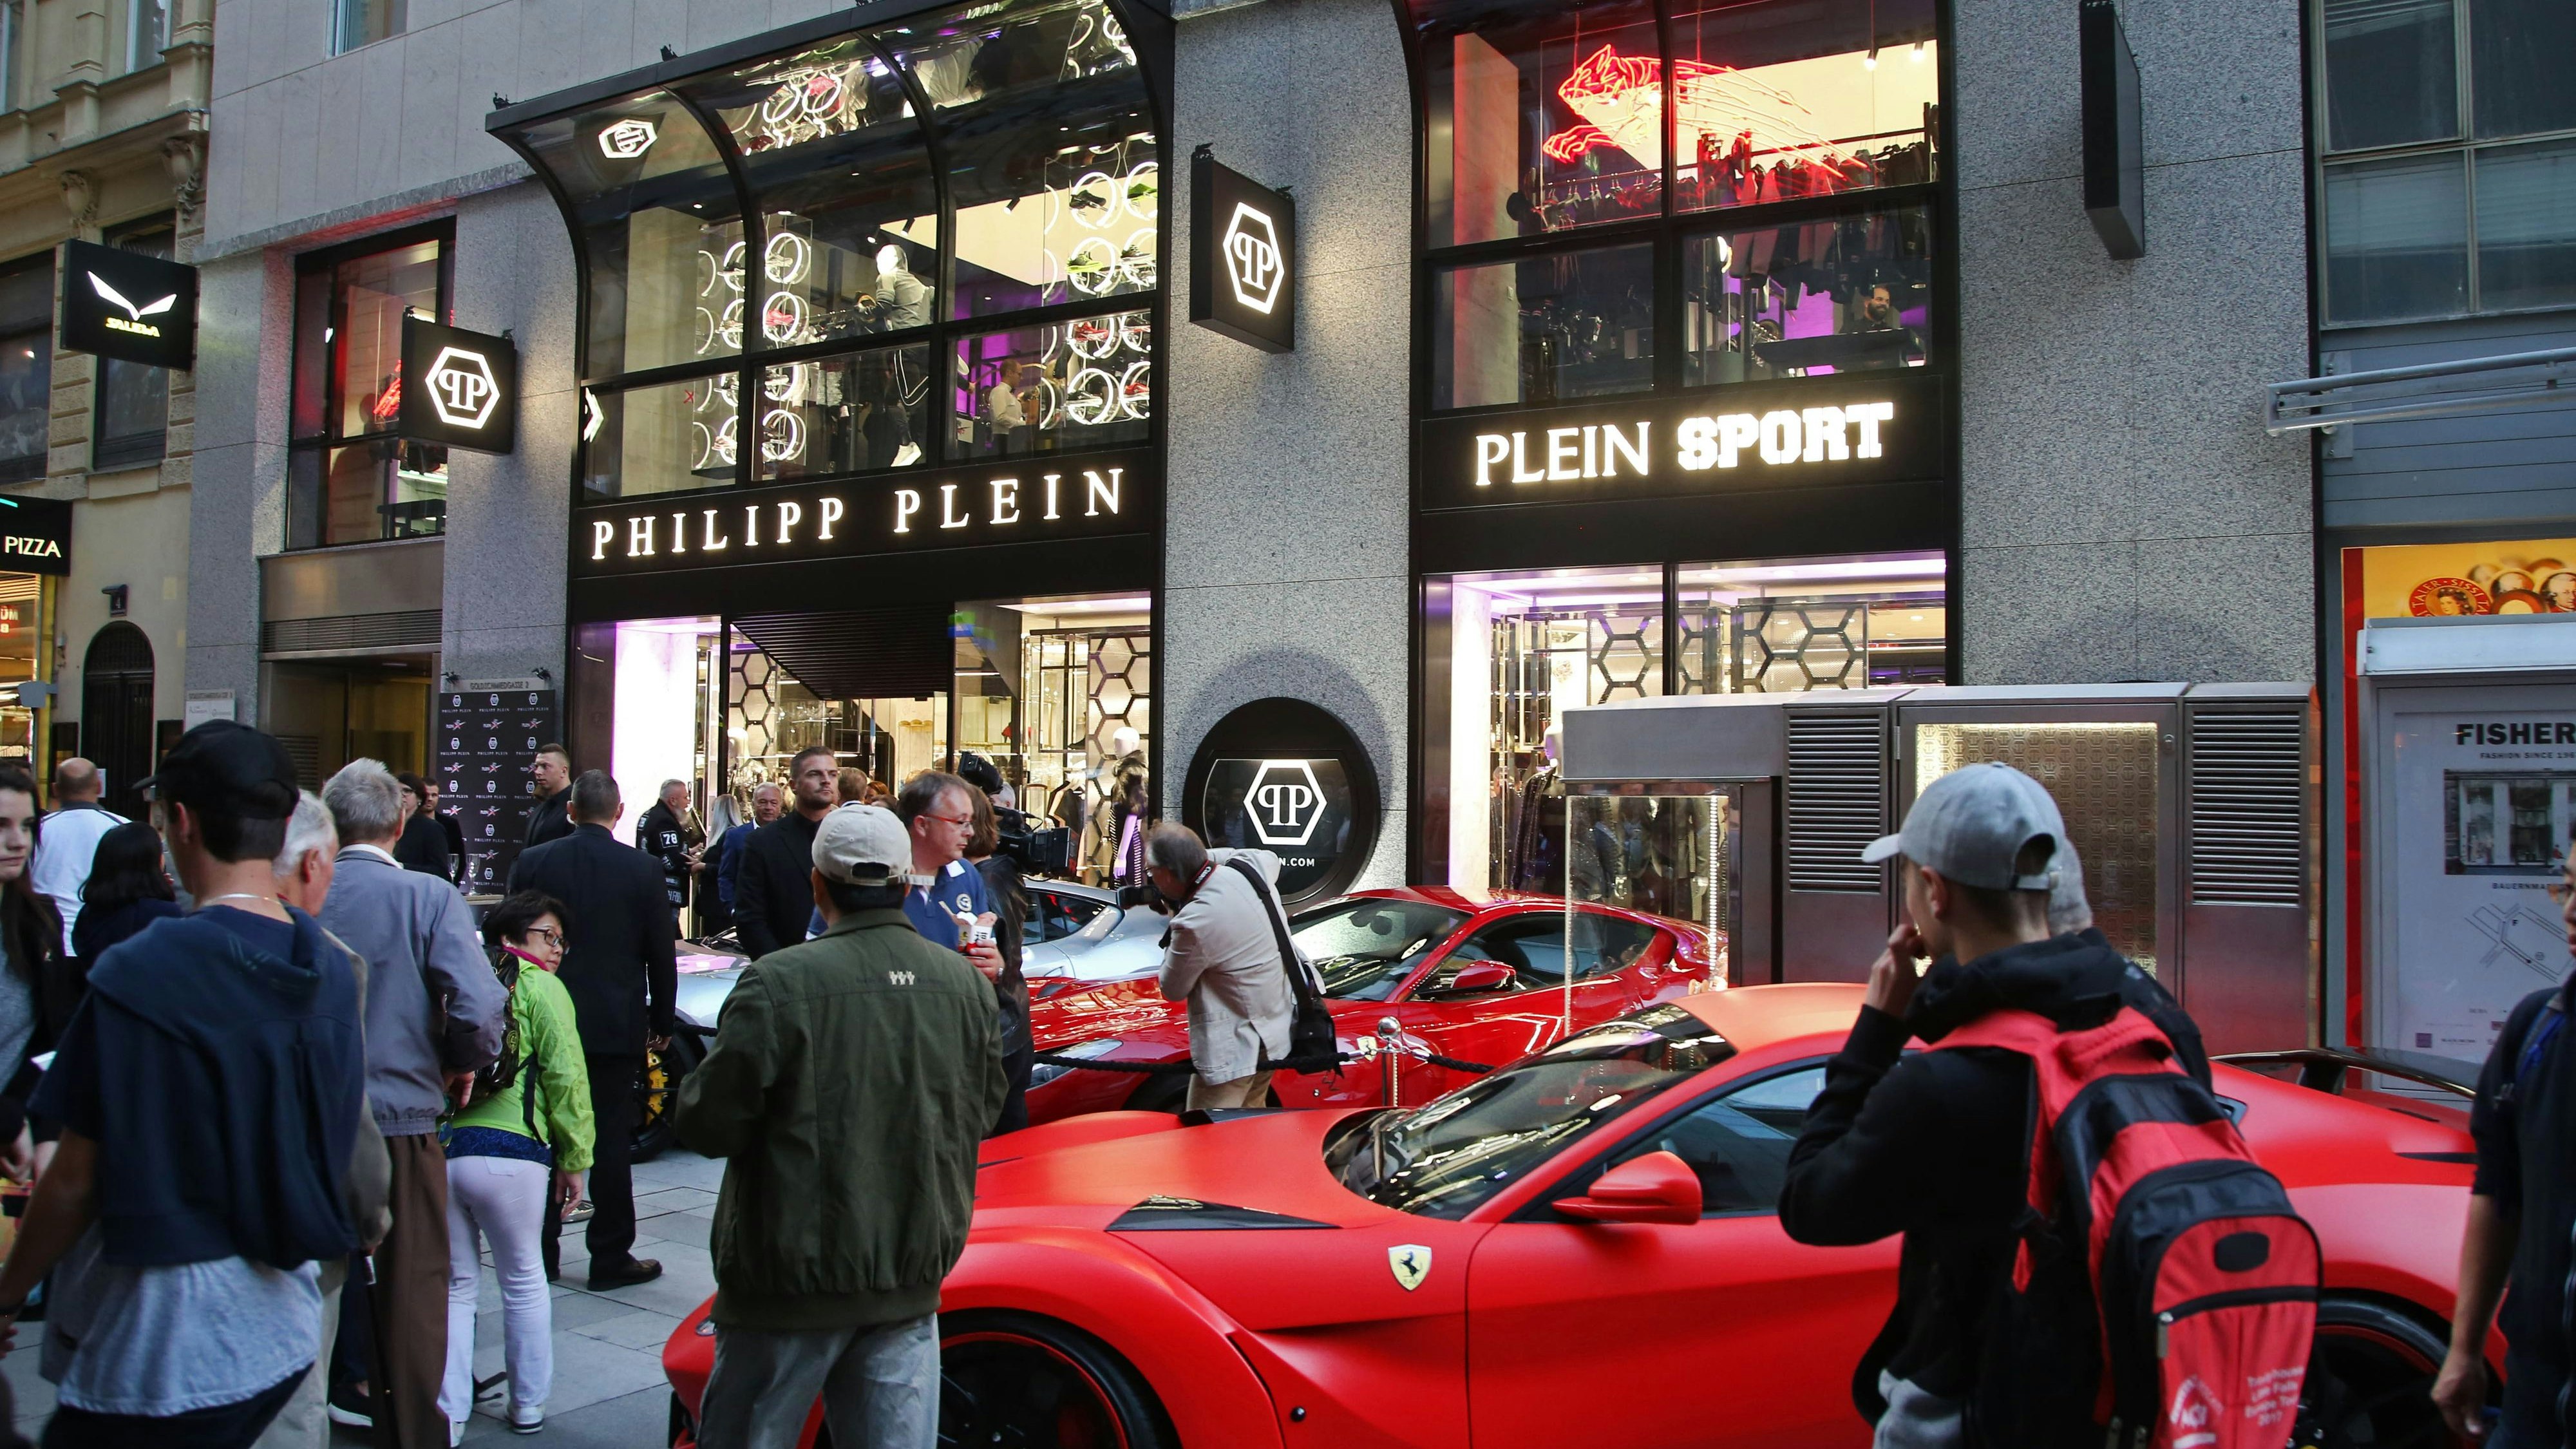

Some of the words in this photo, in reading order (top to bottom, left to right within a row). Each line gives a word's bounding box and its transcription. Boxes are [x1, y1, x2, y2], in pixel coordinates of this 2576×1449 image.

[1475, 421, 1651, 487] PLEIN
[1677, 401, 1894, 471] SPORT
[591, 497, 844, 560] PHILIPP
[893, 468, 1124, 533] PLEIN
[5, 535, 62, 558] PIZZA
[2411, 580, 2442, 609] TALER
[2450, 579, 2485, 596] SISSI
[2457, 723, 2576, 745] FISHER
[663, 833, 677, 844] 78
[1278, 857, 1315, 867] N.COM
